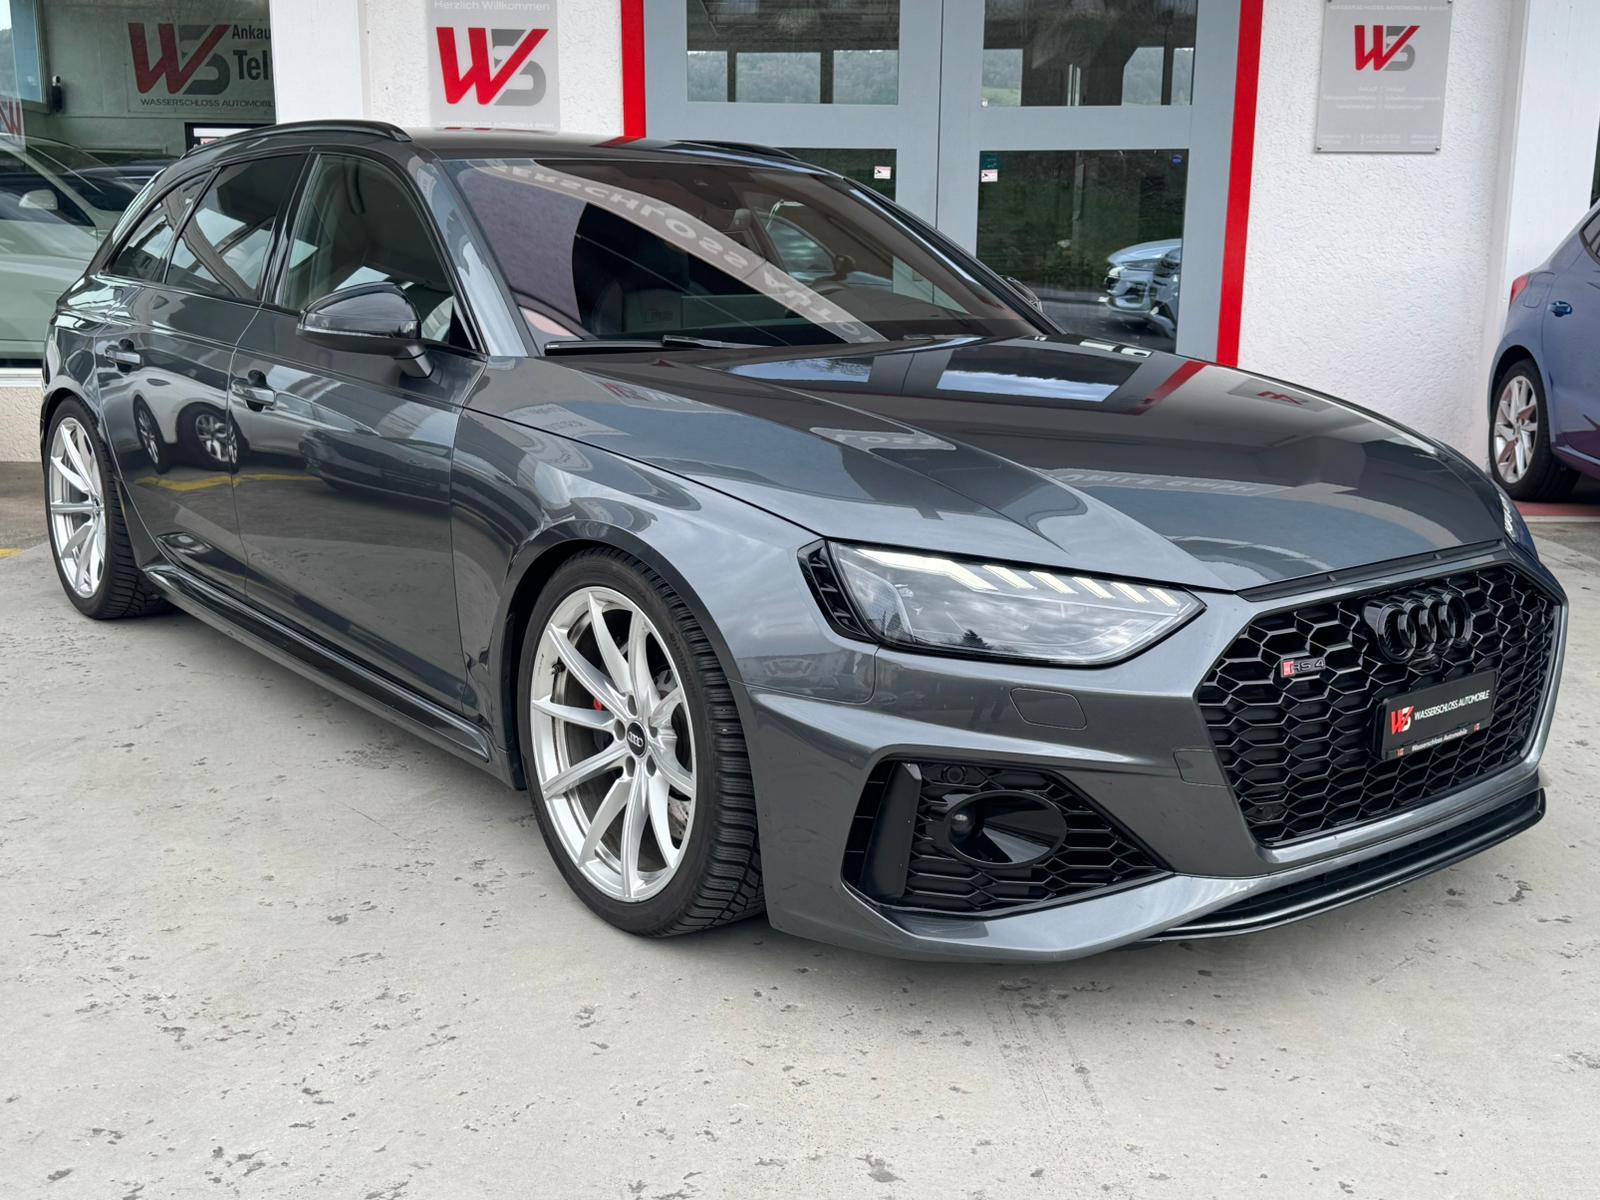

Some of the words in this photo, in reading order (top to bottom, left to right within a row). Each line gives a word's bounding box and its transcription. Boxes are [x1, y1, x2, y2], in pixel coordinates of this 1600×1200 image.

[434, 0, 479, 10] Herzlich
[481, 0, 550, 11] Willkommen
[140, 98, 220, 108] WASSERSCHLOSS
[1414, 699, 1459, 721] WASSERSCHLOSS
[1459, 689, 1491, 707] AUTOMOBILE
